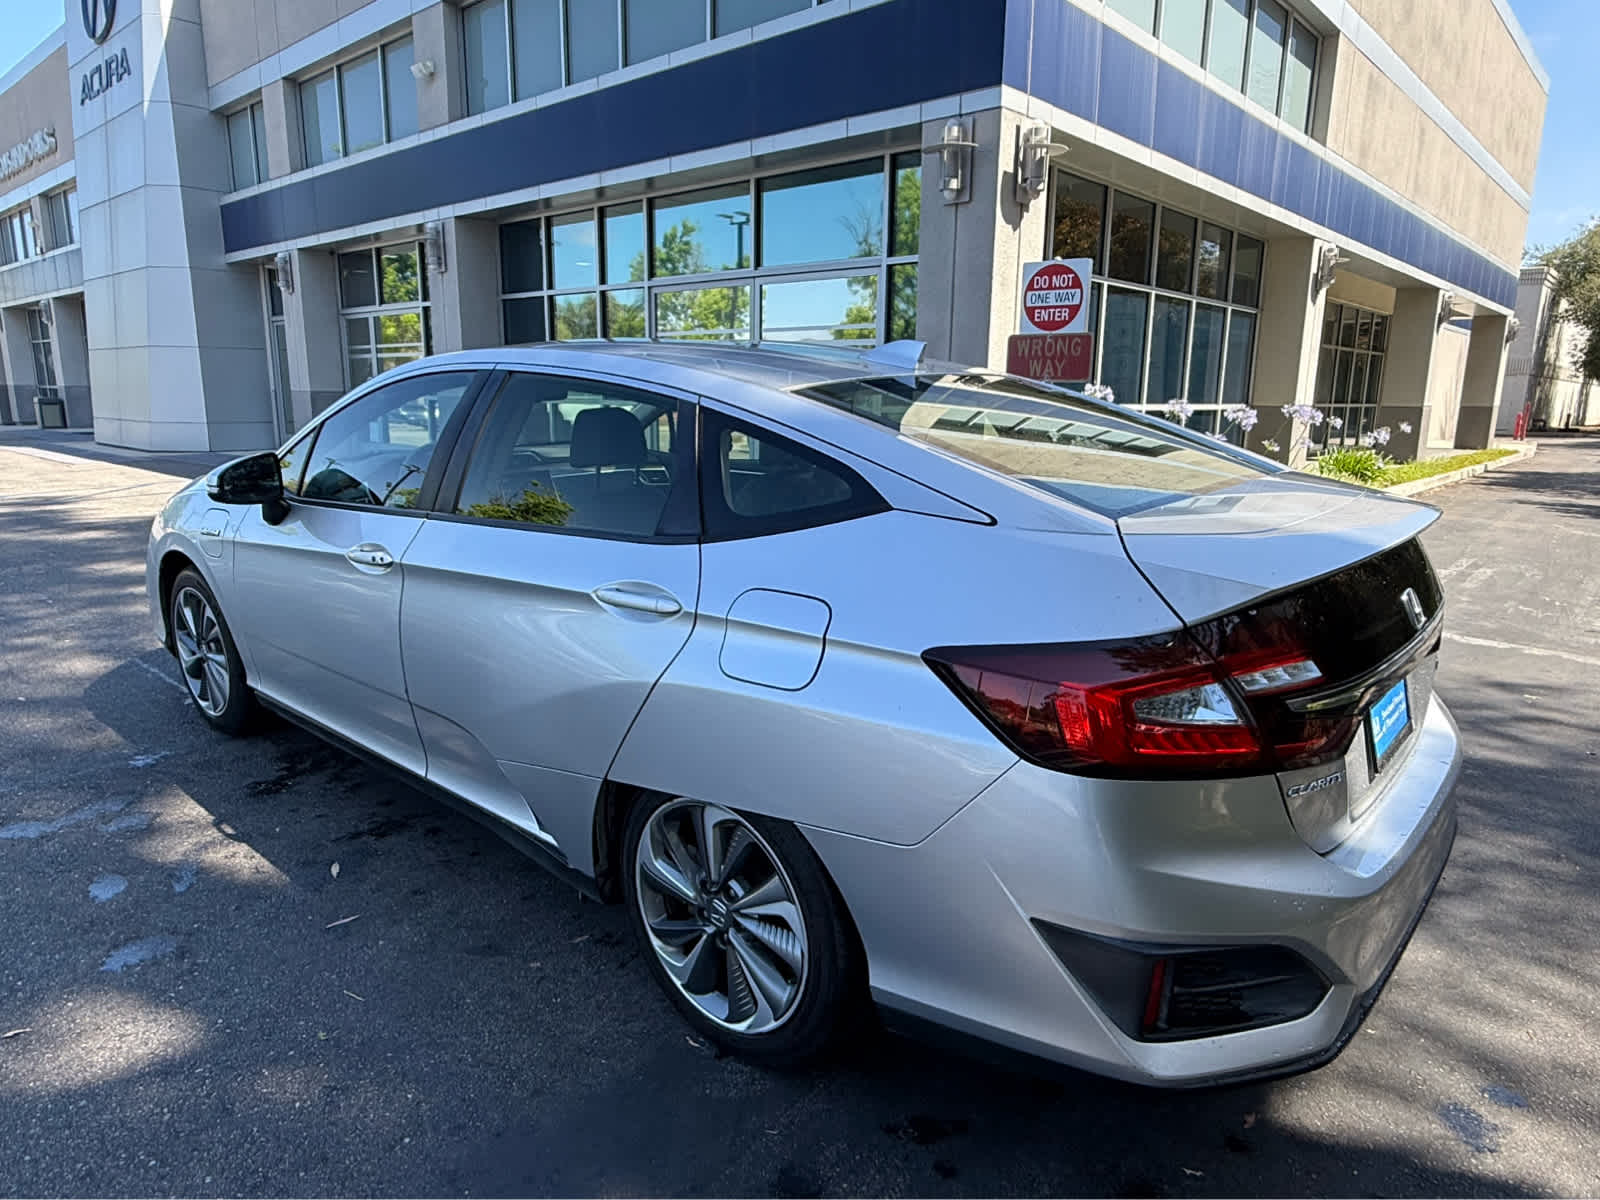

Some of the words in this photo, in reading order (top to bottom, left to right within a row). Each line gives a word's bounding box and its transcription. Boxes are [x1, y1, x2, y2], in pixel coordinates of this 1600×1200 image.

[80, 47, 132, 106] ACURA
[1033, 275, 1049, 289] DO
[1052, 273, 1075, 288] NOT
[1030, 292, 1051, 305] ONE
[1055, 290, 1077, 303] WAY
[1034, 308, 1069, 322] ENTER
[1017, 336, 1081, 359] WRONG
[1029, 359, 1066, 378] WAY
